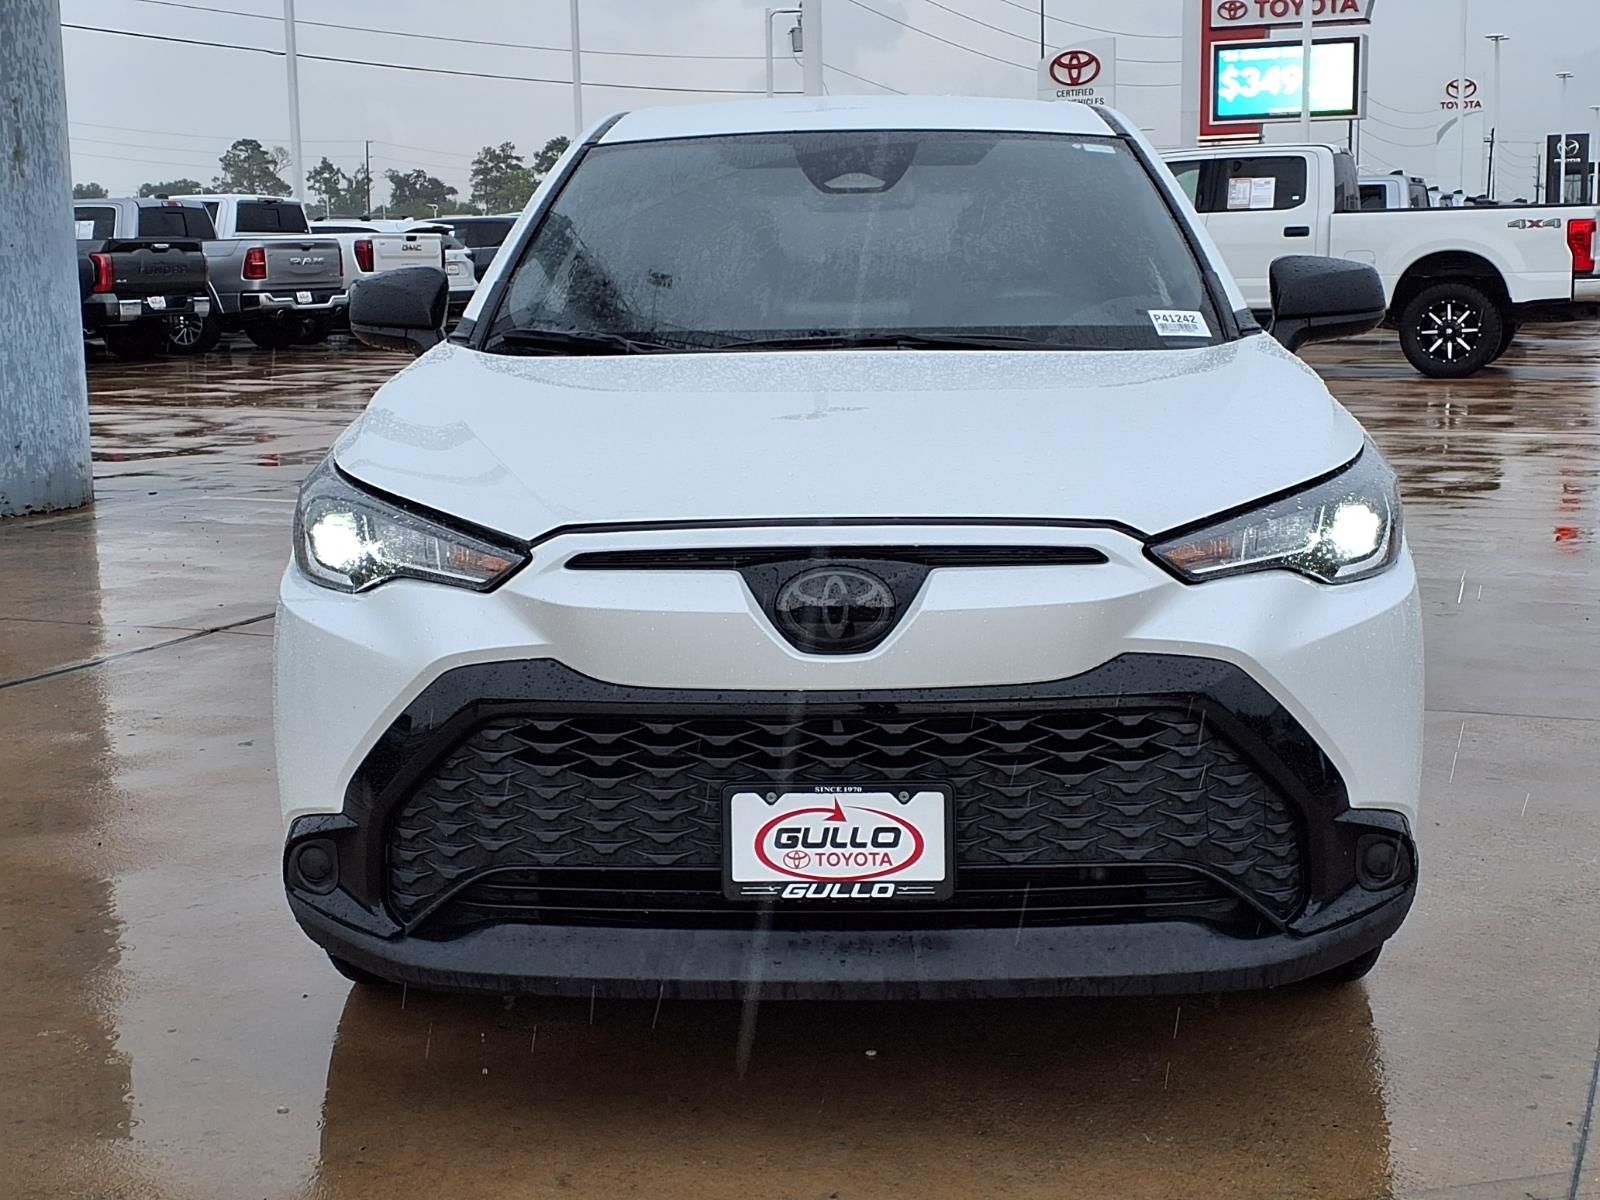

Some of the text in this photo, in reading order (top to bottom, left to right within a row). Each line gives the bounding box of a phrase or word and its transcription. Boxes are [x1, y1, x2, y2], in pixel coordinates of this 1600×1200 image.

[1254, 0, 1359, 18] TOYOTA
[1218, 63, 1301, 103] $349
[1056, 88, 1094, 98] CERTIFIED
[1071, 97, 1105, 105] HICLES
[401, 244, 422, 252] GMC
[289, 256, 324, 266] RAM
[1153, 314, 1198, 323] P41242
[774, 826, 902, 850] GULLO
[815, 852, 893, 867] TOYOTA
[781, 883, 895, 899] GULLO
